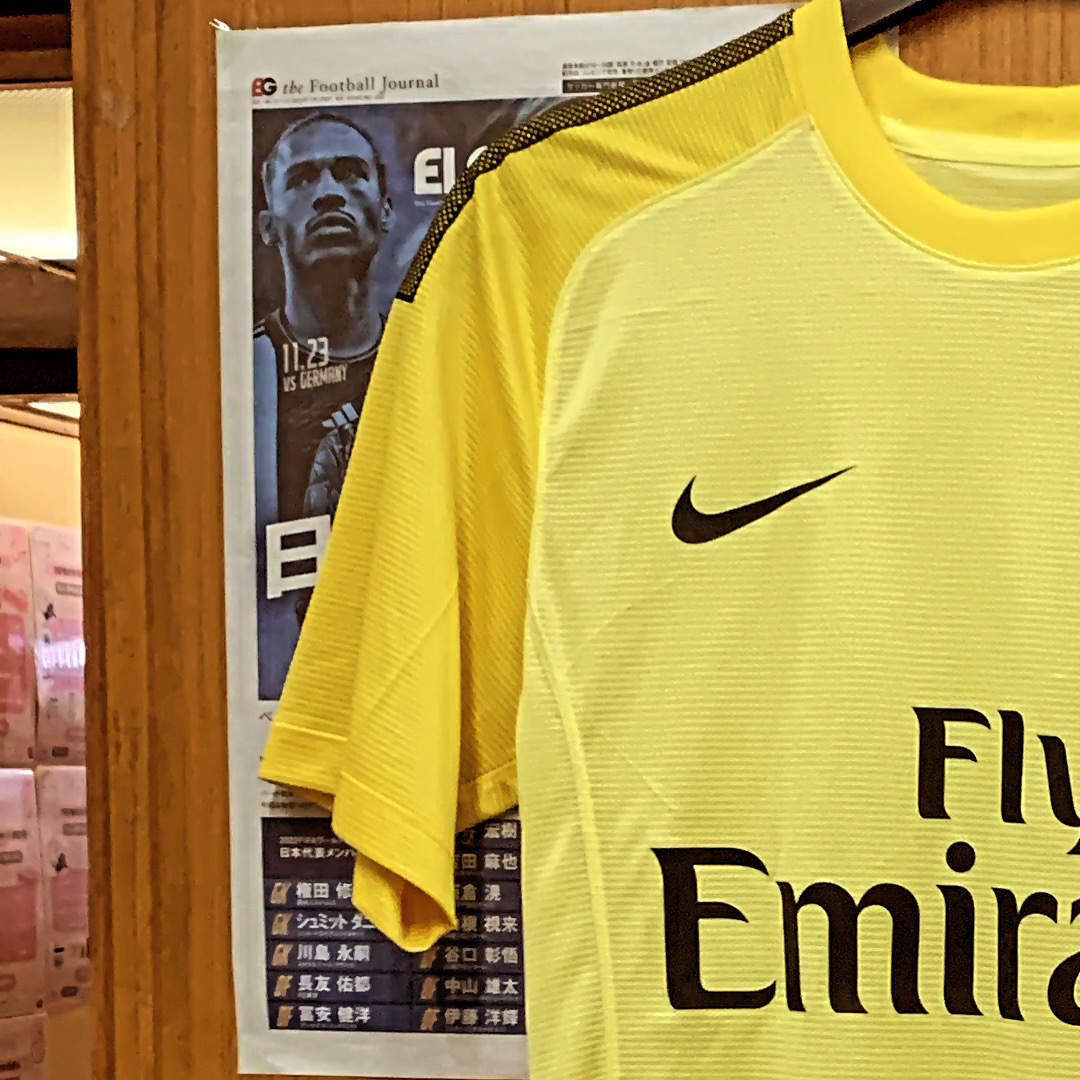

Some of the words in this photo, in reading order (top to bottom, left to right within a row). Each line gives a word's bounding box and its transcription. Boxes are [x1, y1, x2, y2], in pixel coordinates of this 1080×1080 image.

[282, 80, 304, 94] the
[310, 76, 375, 93] Football
[380, 73, 439, 94] Journal
[283, 337, 329, 373] 11.23
[300, 364, 348, 390] GERMANY
